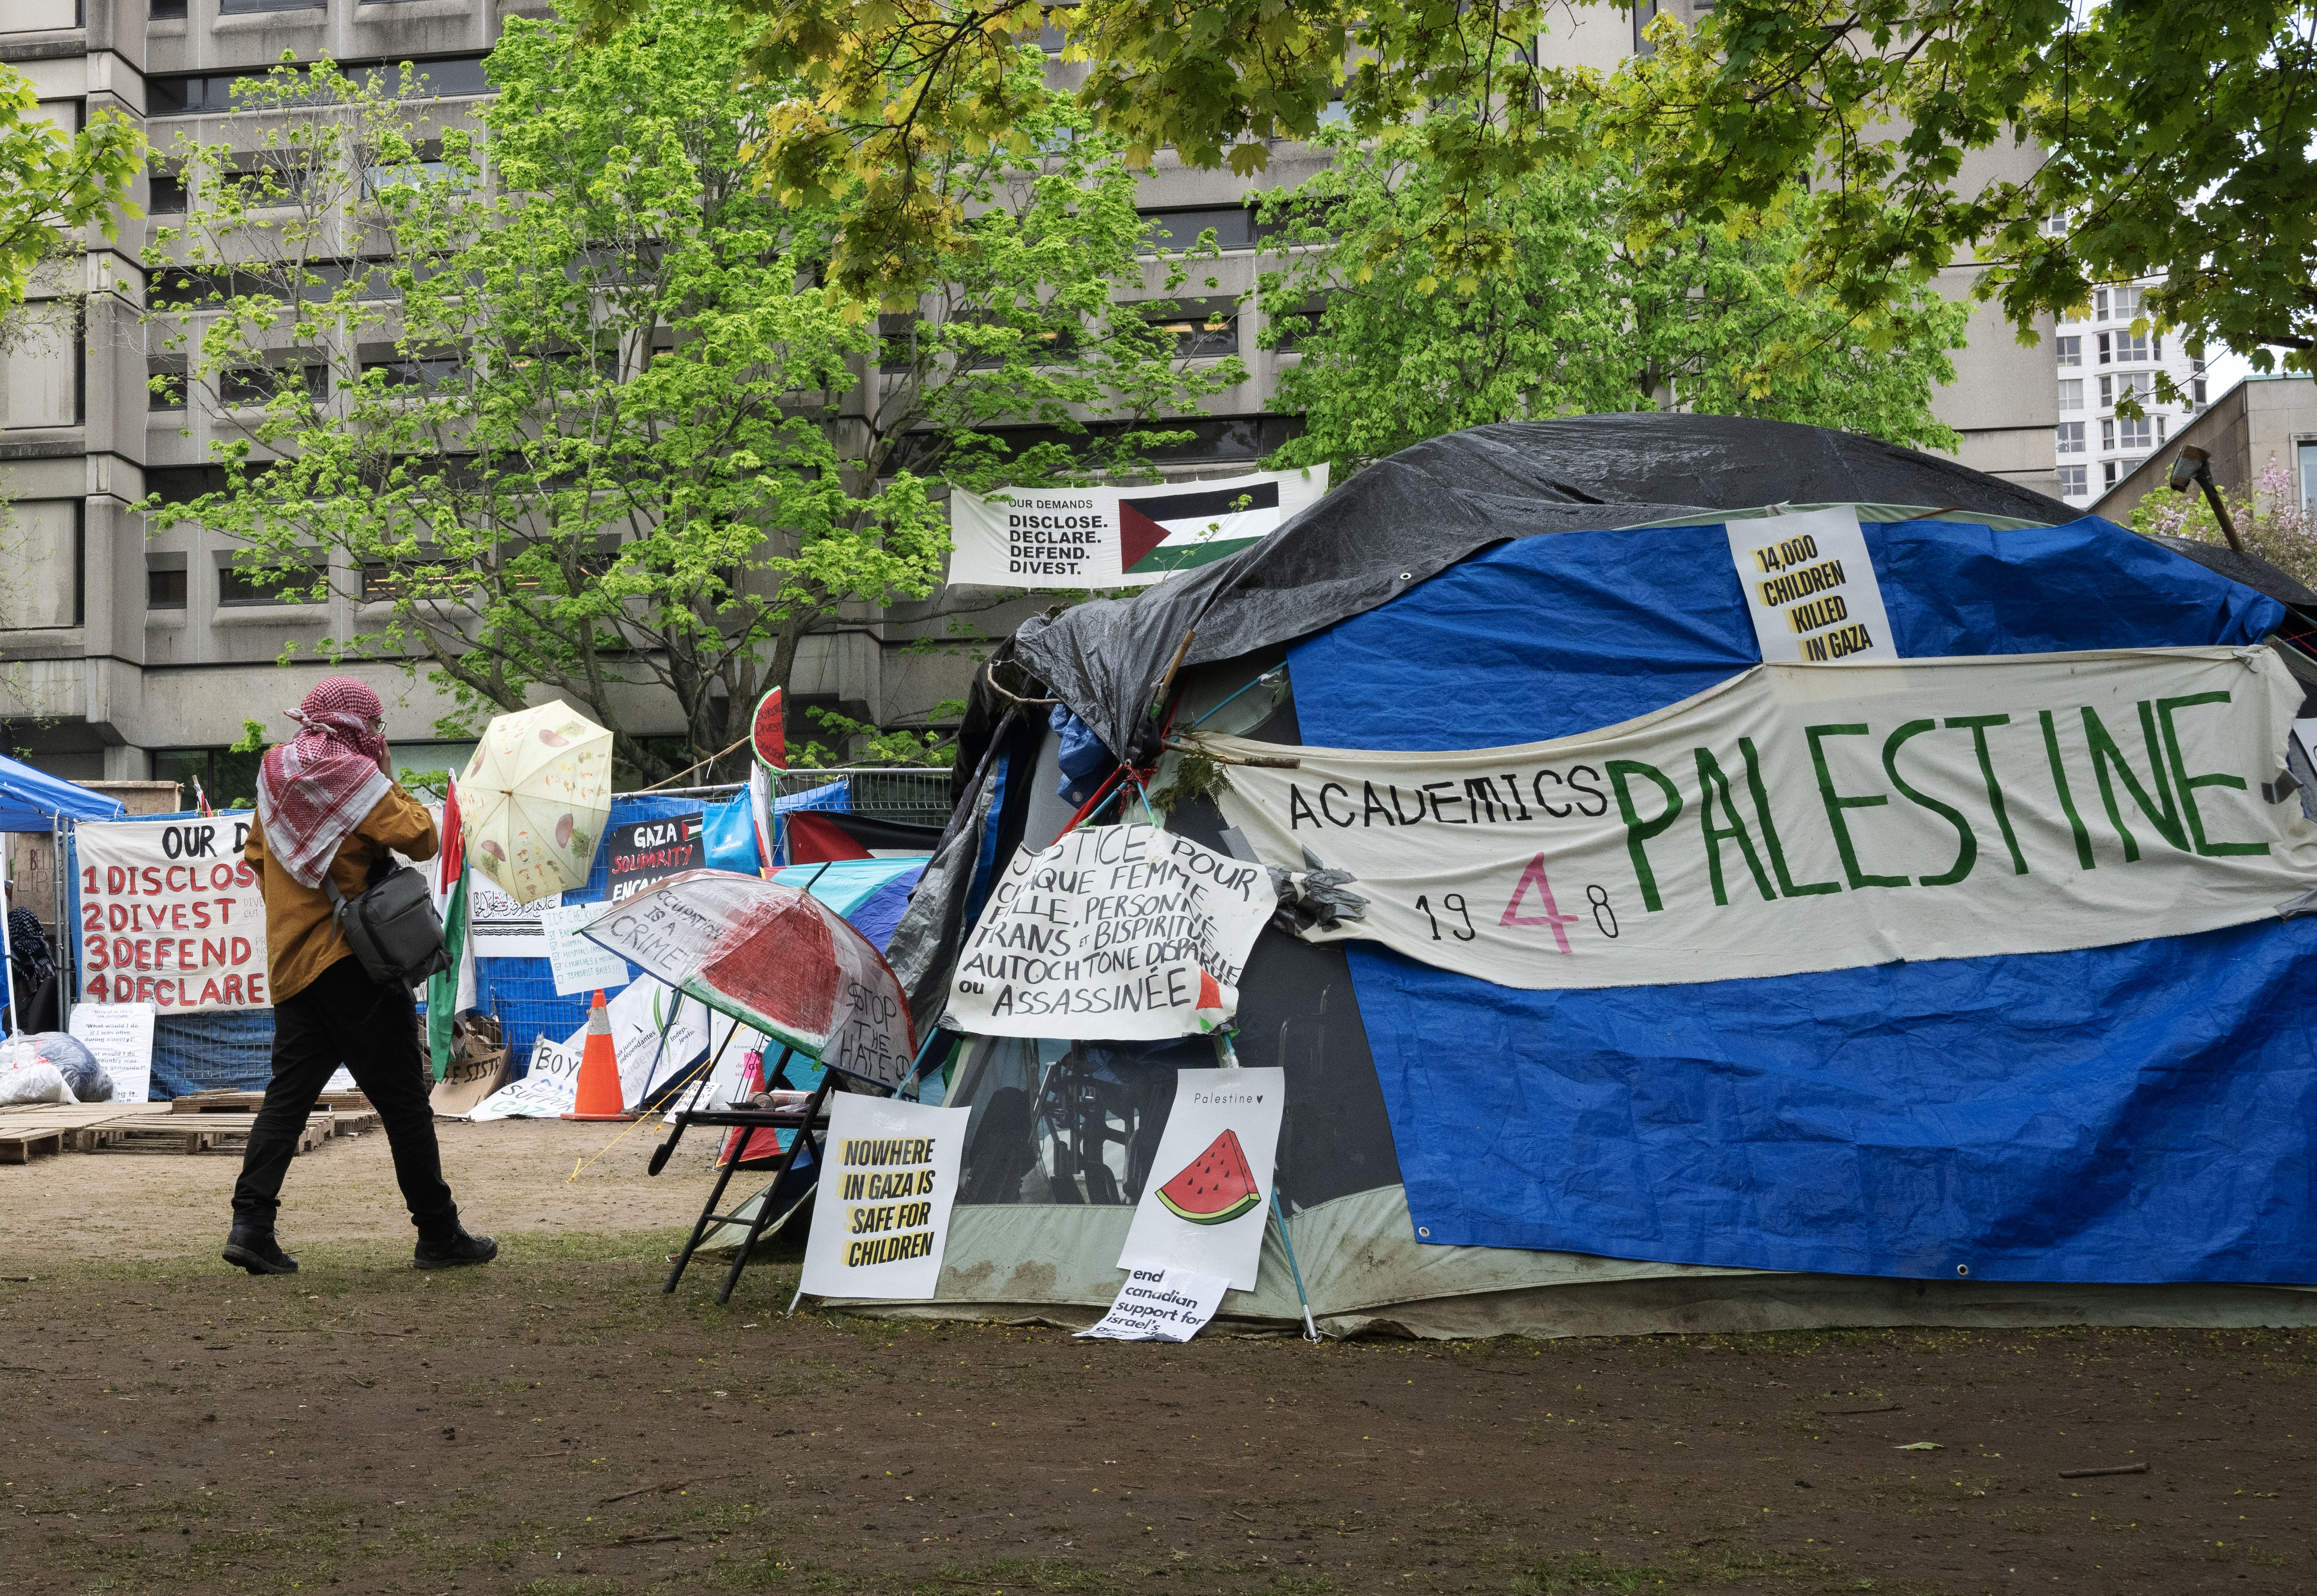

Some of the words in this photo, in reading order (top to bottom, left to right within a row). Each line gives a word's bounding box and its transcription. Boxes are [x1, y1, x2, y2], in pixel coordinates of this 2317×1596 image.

[1009, 498, 1032, 508] OUR
[1037, 500, 1093, 509] DEMANDS
[1009, 515, 1108, 529] DISCLOSE.
[1009, 530, 1101, 544] DECLARE.
[1009, 560, 1081, 574] DIVEST.
[1010, 545, 1090, 559] DEFEND.
[1757, 535, 1818, 573] 14,000
[1763, 559, 1846, 607] CHILDREN
[1791, 595, 1848, 634] KILLED
[1806, 636, 1828, 661] IN
[1828, 623, 1874, 658] GAZA
[1291, 764, 1608, 830] ACADEMICS
[1604, 691, 2270, 912] PALESTINE
[162, 826, 217, 859] OUR
[634, 823, 677, 848] GAZA
[612, 844, 693, 874] SOLIDARITY
[1013, 823, 1153, 876] JUSTICE
[1171, 840, 1257, 902] POUR
[82, 865, 100, 894] 1
[108, 859, 260, 896] DISCLOS
[998, 868, 1096, 903] CHAQUE
[1110, 860, 1209, 911] FEMME
[82, 902, 105, 931] 2
[109, 898, 236, 932] DIVEST
[546, 912, 564, 926] IDF
[644, 905, 665, 922] IS
[662, 922, 676, 936] A
[988, 896, 1079, 928] FILLE,
[85, 934, 110, 971] 3
[114, 937, 251, 971] DEFEND
[561, 939, 582, 948] WOMEN
[564, 948, 589, 958] HOSPITALS
[611, 915, 690, 970] CRIME
[974, 921, 1070, 956] TRANS
[1079, 935, 1090, 947] ET
[565, 958, 592, 967] CHURCHES
[567, 967, 592, 980] TERRORIST
[87, 973, 109, 1003] 4
[992, 966, 1191, 1016] ASSASSINÉE
[620, 1030, 656, 1064] indépendantes
[623, 1036, 636, 1053] juives
[642, 1035, 659, 1049] Montréal
[853, 1020, 890, 1053] THE
[840, 1030, 891, 1083] HATE
[501, 1085, 575, 1111] SUPPOR
[1194, 1093, 1253, 1104] Palestine
[844, 1139, 936, 1166] NOWHERE
[844, 1174, 865, 1200] IN
[868, 1173, 913, 1200] GAZA
[917, 1170, 935, 1195] IS
[851, 1206, 895, 1234] SAFE
[897, 1202, 931, 1229] FOR
[849, 1232, 934, 1267] CHILDREN
[1134, 1270, 1166, 1282] end
[1125, 1287, 1198, 1309] canadian
[1106, 1313, 1161, 1331] israel’s
[1116, 1302, 1178, 1321] support
[1180, 1311, 1206, 1325] for
